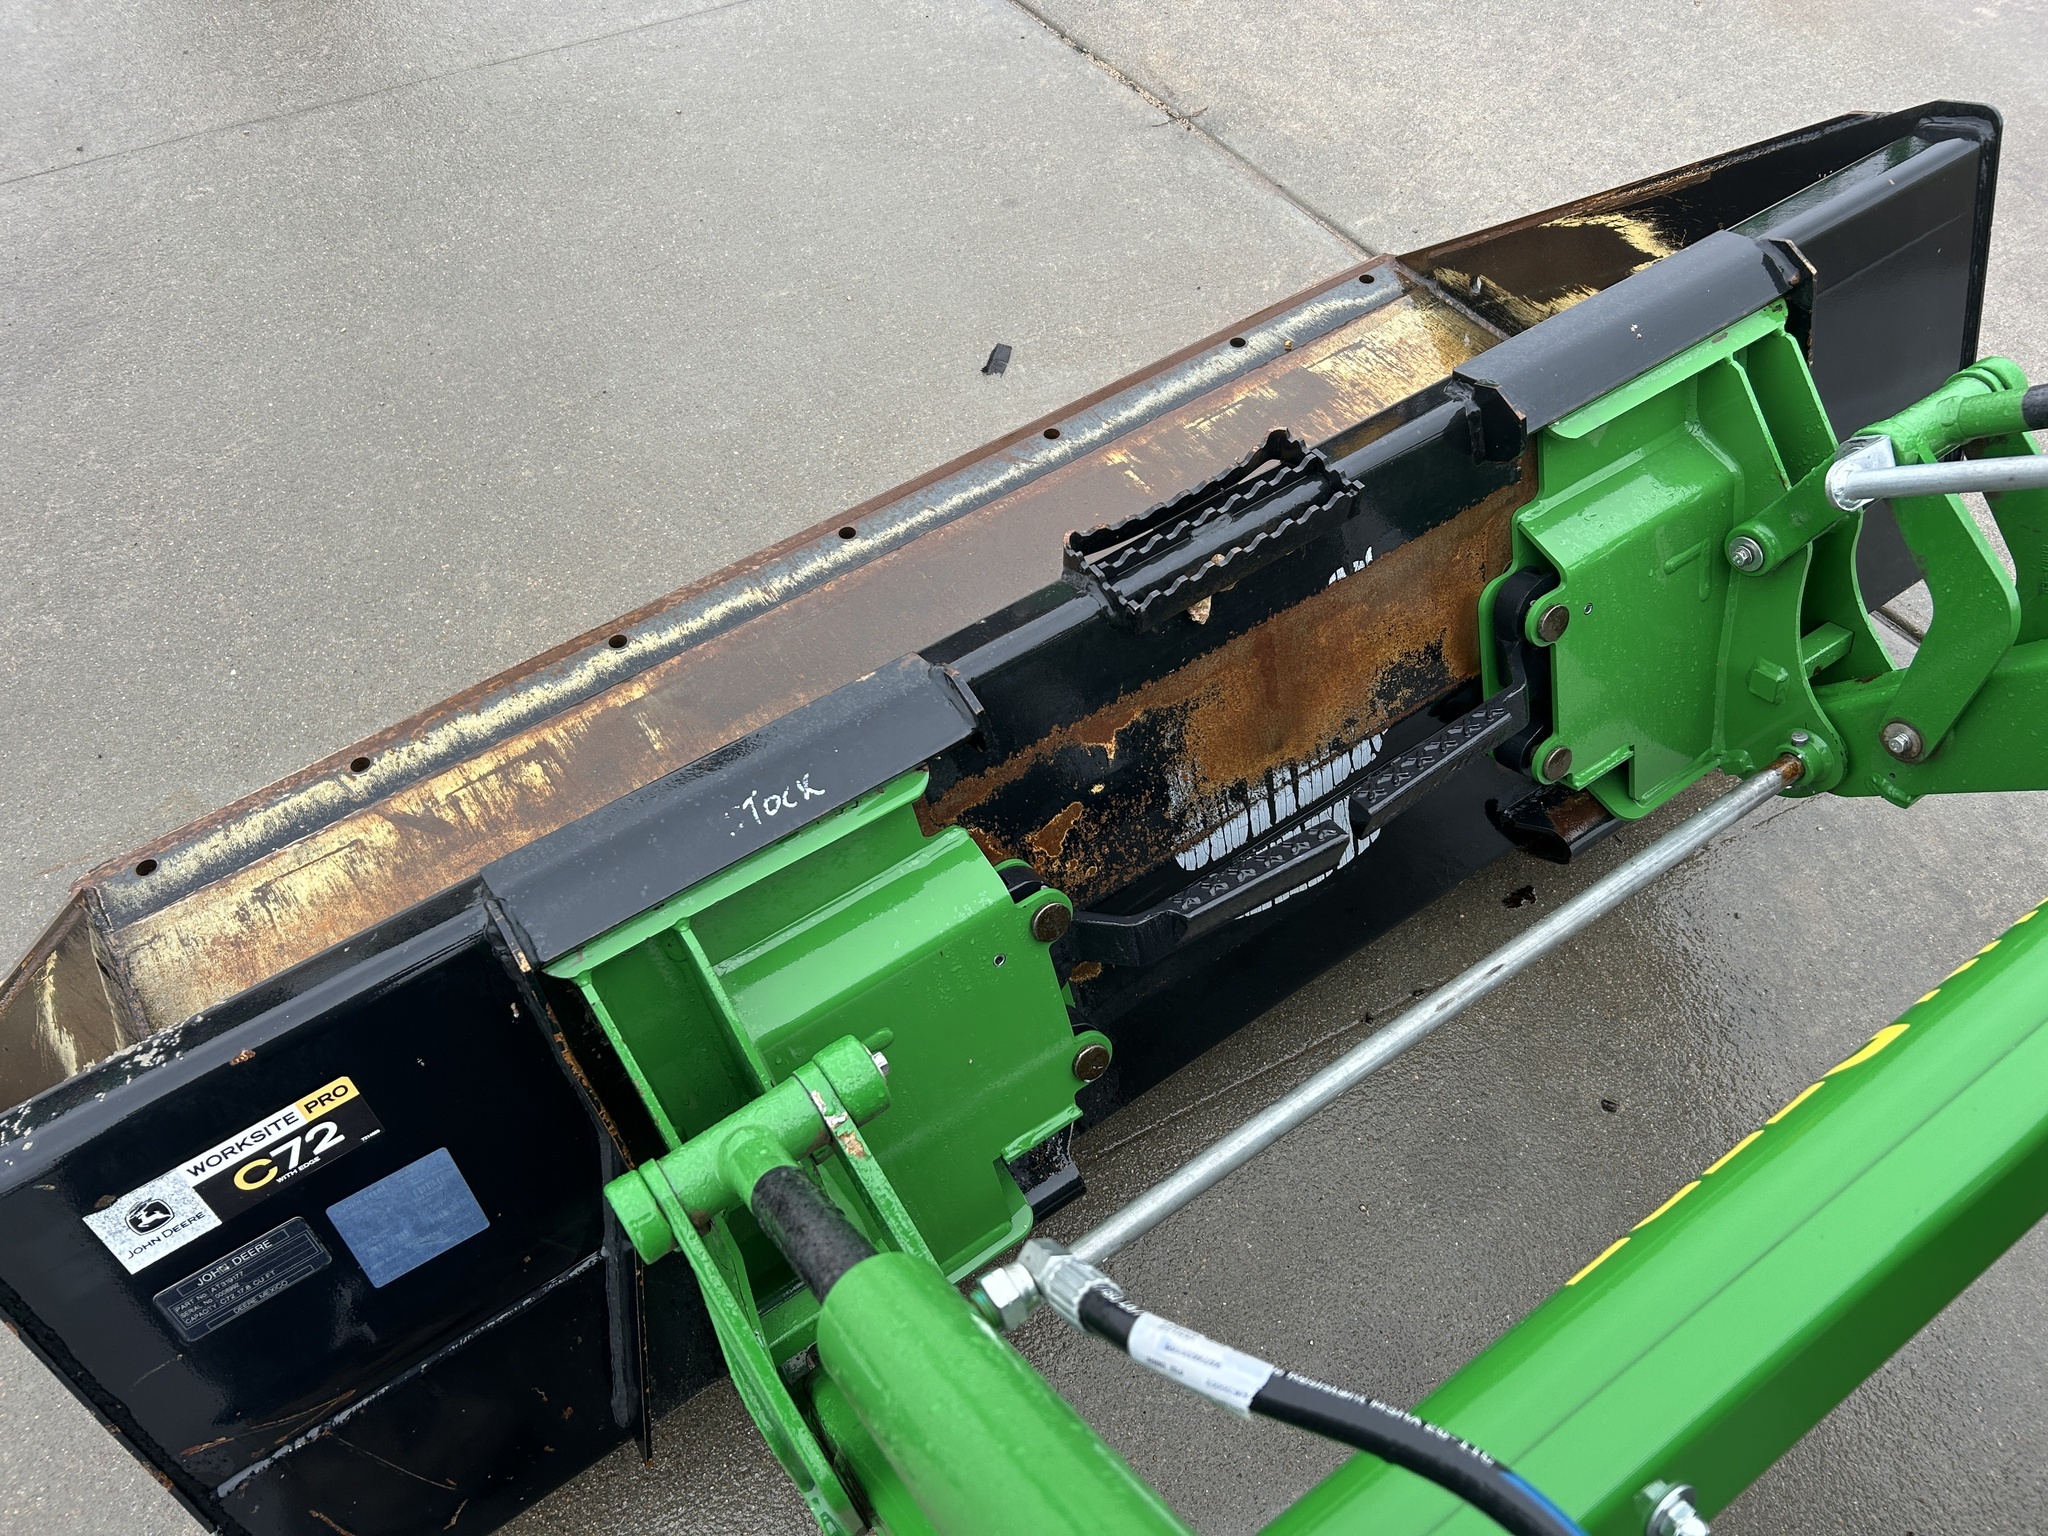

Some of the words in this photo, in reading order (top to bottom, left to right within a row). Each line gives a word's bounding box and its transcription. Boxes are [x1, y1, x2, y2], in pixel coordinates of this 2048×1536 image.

[186, 1111, 300, 1177] WORKSITE
[303, 1084, 349, 1114] PRO
[233, 1120, 346, 1191] C72
[275, 1167, 298, 1184] WITH
[298, 1155, 321, 1174] EDGE
[127, 1236, 160, 1260] JOHN
[163, 1211, 205, 1241] DEERE
[197, 1263, 230, 1287] JOHN
[231, 1239, 273, 1266] DEERE
[173, 1298, 195, 1313] PART
[179, 1304, 203, 1319] SERIAL
[185, 1303, 217, 1325] CAPACITY
[219, 1293, 236, 1306] C72
[252, 1275, 265, 1287] CU
[265, 1269, 277, 1280] FT
[232, 1297, 258, 1314] DEERE
[258, 1279, 289, 1300] MEXICO
